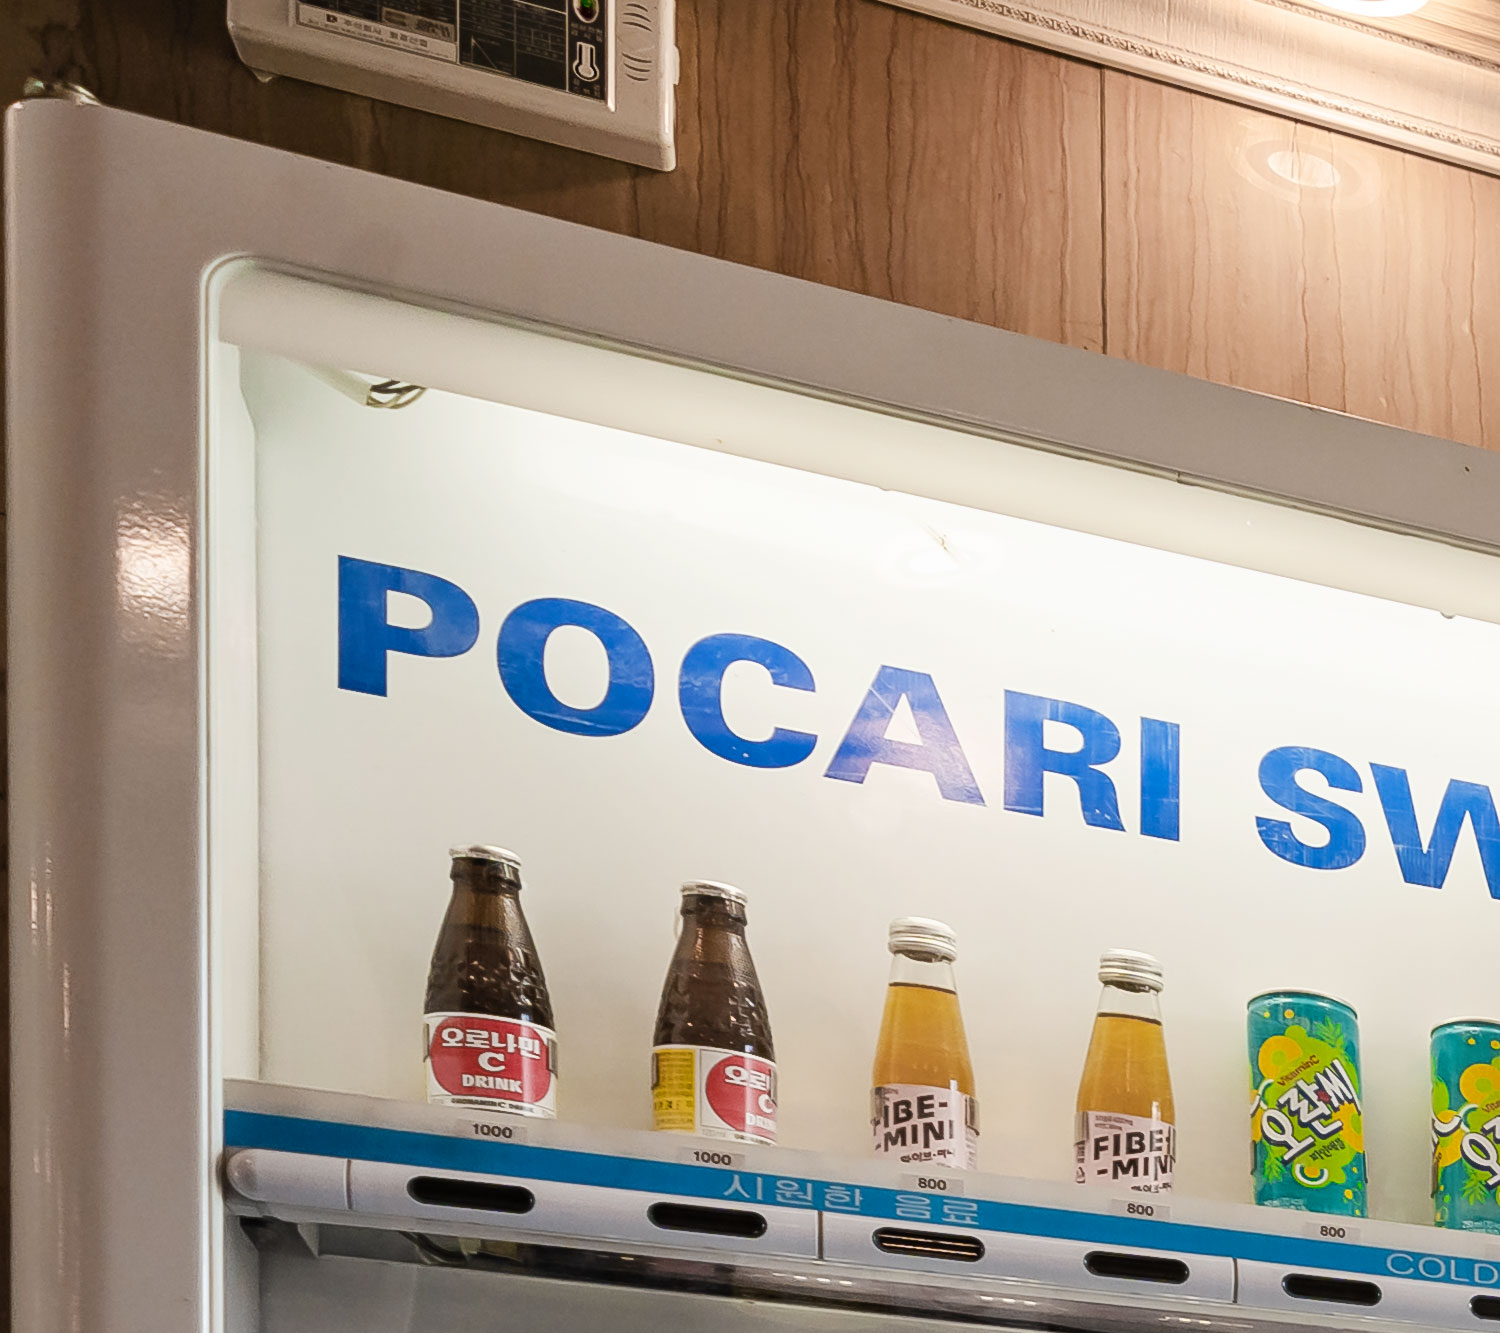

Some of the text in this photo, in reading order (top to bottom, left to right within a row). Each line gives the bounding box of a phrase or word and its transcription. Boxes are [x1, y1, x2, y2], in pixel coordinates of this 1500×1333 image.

[337, 554, 1180, 842] POCARI
[441, 1027, 541, 1060] 오로나민
[478, 1052, 506, 1072] C
[461, 1074, 523, 1095] DRINK
[1261, 1059, 1361, 1165] 오란씨
[472, 1123, 513, 1139] 1000
[693, 1151, 732, 1166] 1000
[917, 1177, 947, 1191] 800
[722, 1174, 980, 1227] 시원한 음료
[1126, 1203, 1154, 1217] 800
[1320, 1225, 1346, 1239] 800
[1386, 1252, 1499, 1285] COLD
